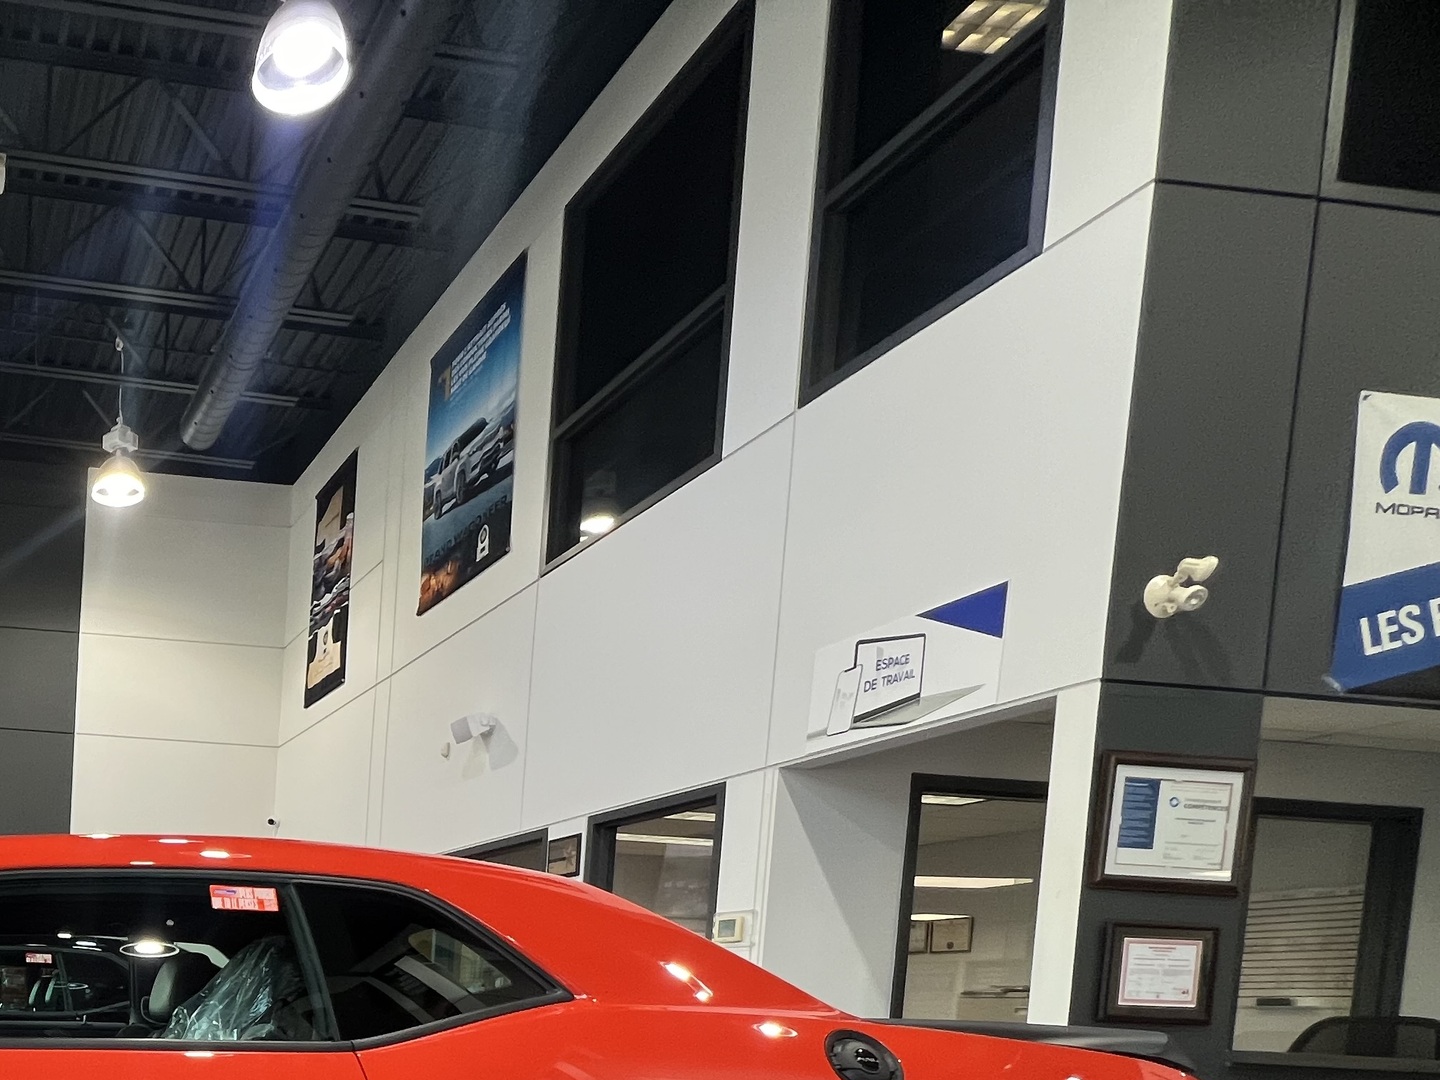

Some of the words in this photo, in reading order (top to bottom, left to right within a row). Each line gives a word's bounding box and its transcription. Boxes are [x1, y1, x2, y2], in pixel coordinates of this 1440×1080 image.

[1360, 604, 1425, 656] LES
[875, 653, 910, 671] ESPACE
[863, 678, 878, 693] DE
[881, 669, 915, 687] TRAVAIL
